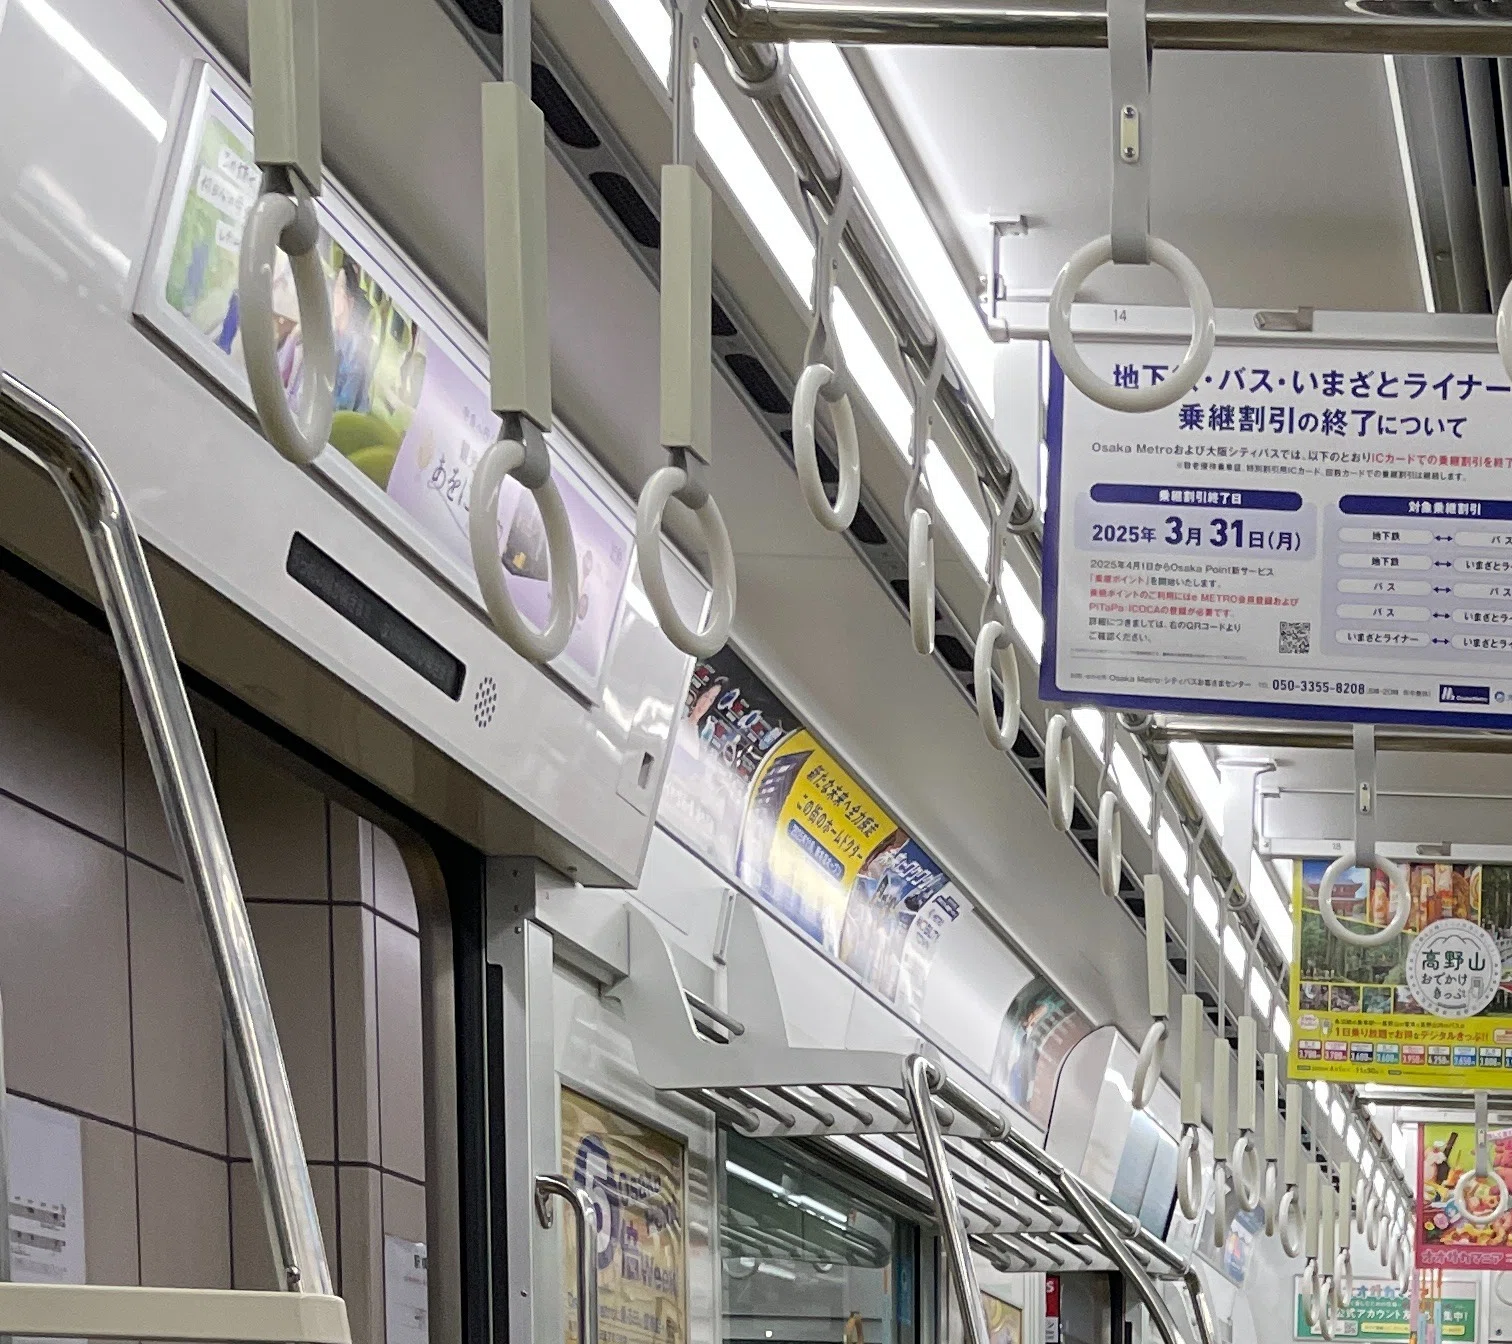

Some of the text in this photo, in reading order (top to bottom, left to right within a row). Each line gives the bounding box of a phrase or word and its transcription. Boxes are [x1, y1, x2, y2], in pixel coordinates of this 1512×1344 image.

[1113, 309, 1127, 321] 14
[1178, 403, 1467, 439] 乗継割引の終了について
[1091, 442, 1132, 454] Osaka
[1159, 489, 1242, 505] 乗継割引終了日
[1408, 501, 1482, 516] 対象乗継割引
[1092, 516, 1301, 551] 2025年 3月 31日(月)
[1372, 531, 1400, 541] 地下鉄
[1371, 556, 1399, 567] 地下鉄
[1089, 632, 1152, 643] ご確認ください。
[1347, 633, 1419, 643] いまざとライナー
[1272, 679, 1365, 695] 050-3355-8208
[1422, 949, 1485, 971] 高野山
[1421, 972, 1467, 985] おでかけ
[1421, 1249, 1505, 1265] オオサカマニア
